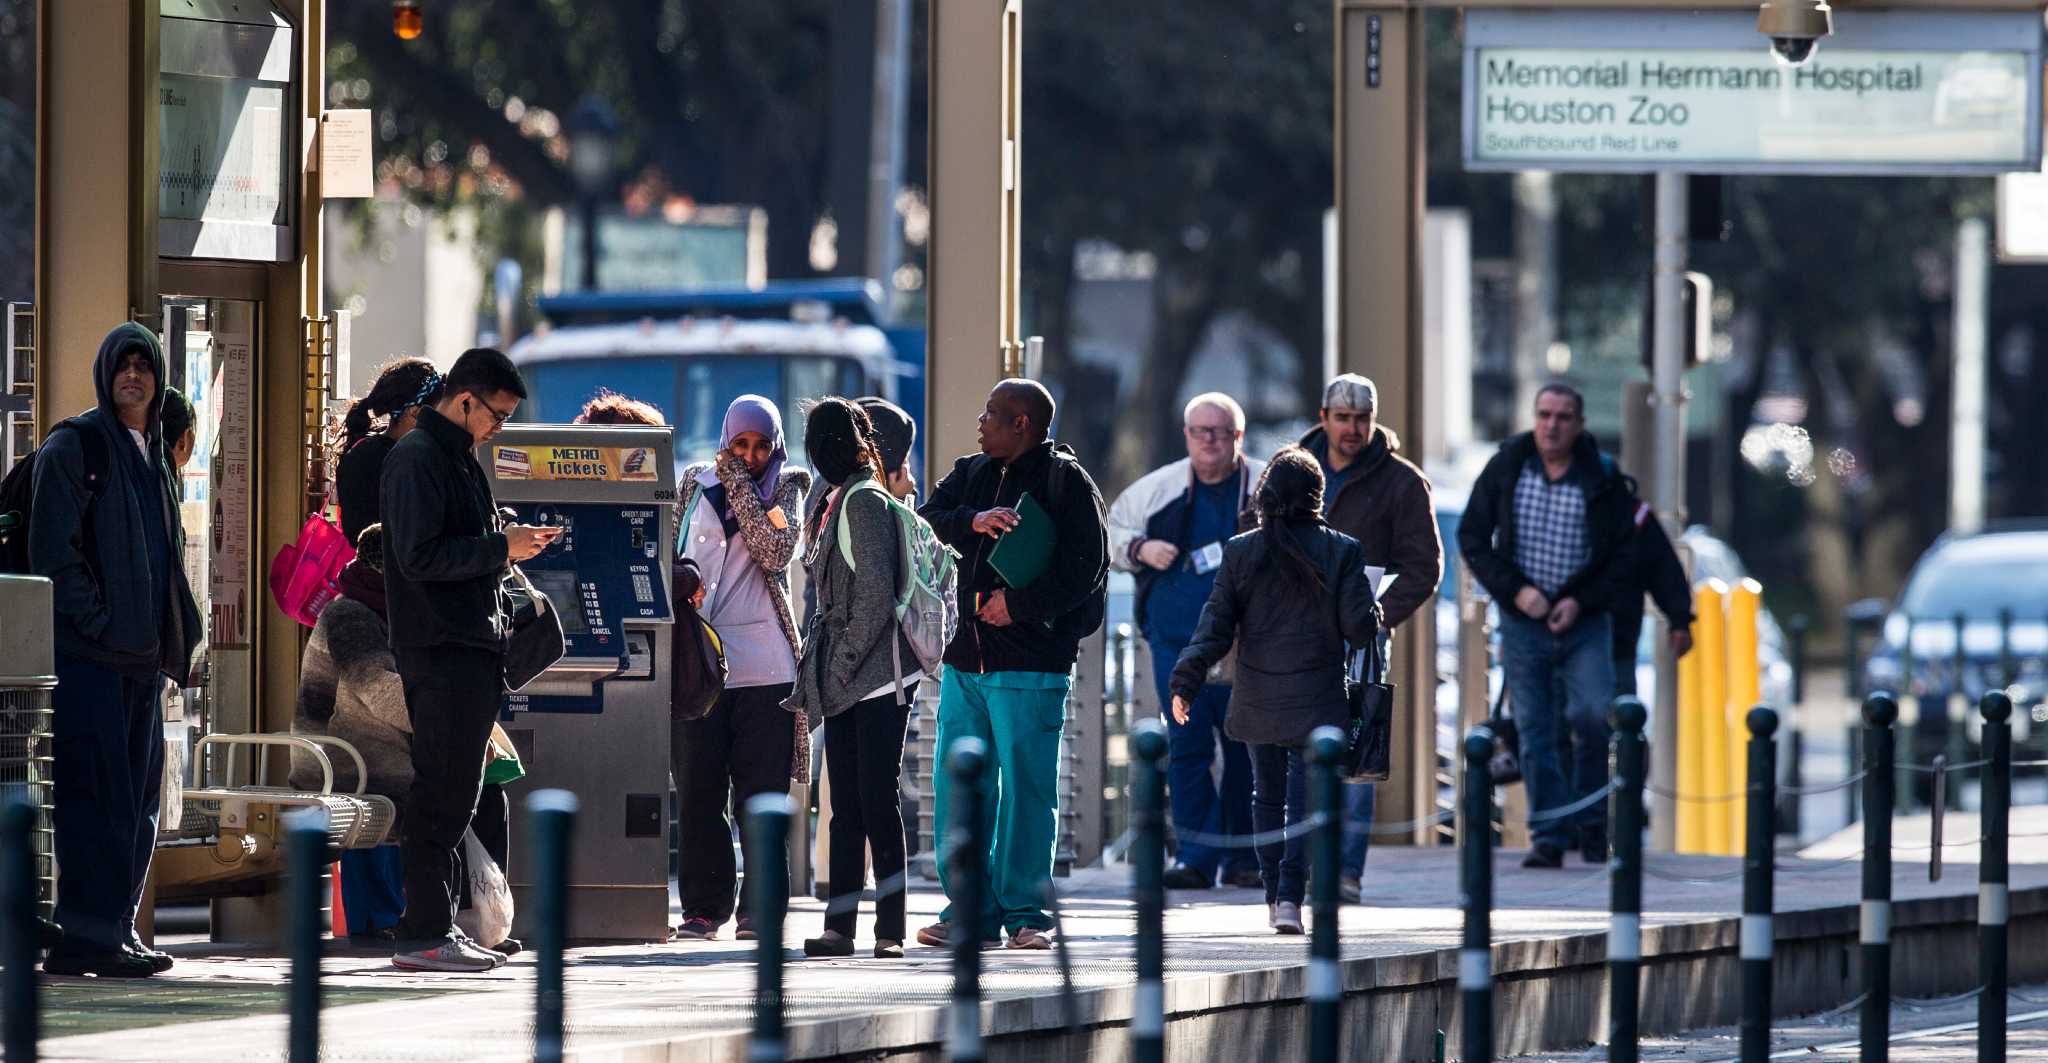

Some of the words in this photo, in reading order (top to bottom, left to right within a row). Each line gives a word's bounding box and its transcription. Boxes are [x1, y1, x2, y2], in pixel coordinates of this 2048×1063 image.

[1486, 60, 1628, 88] Memorial
[1642, 62, 1781, 89] Hermann
[1796, 62, 1922, 94] Hospital
[1486, 97, 1615, 124] Houston
[1629, 97, 1689, 125] Zoo
[1486, 134, 1595, 152] Southbound
[1602, 135, 1637, 151] Red
[1643, 136, 1680, 152] Line
[552, 448, 600, 460] METRO
[548, 461, 607, 476] Tickets
[654, 490, 675, 500] 6034
[621, 510, 654, 518] CREDIT/DEBIT
[630, 517, 644, 525] CARD
[629, 565, 649, 573] KEYPAD
[640, 608, 654, 616] CASH
[212, 603, 236, 644] TVM
[591, 627, 612, 635] CANCEL
[508, 703, 529, 712] CHANGE
